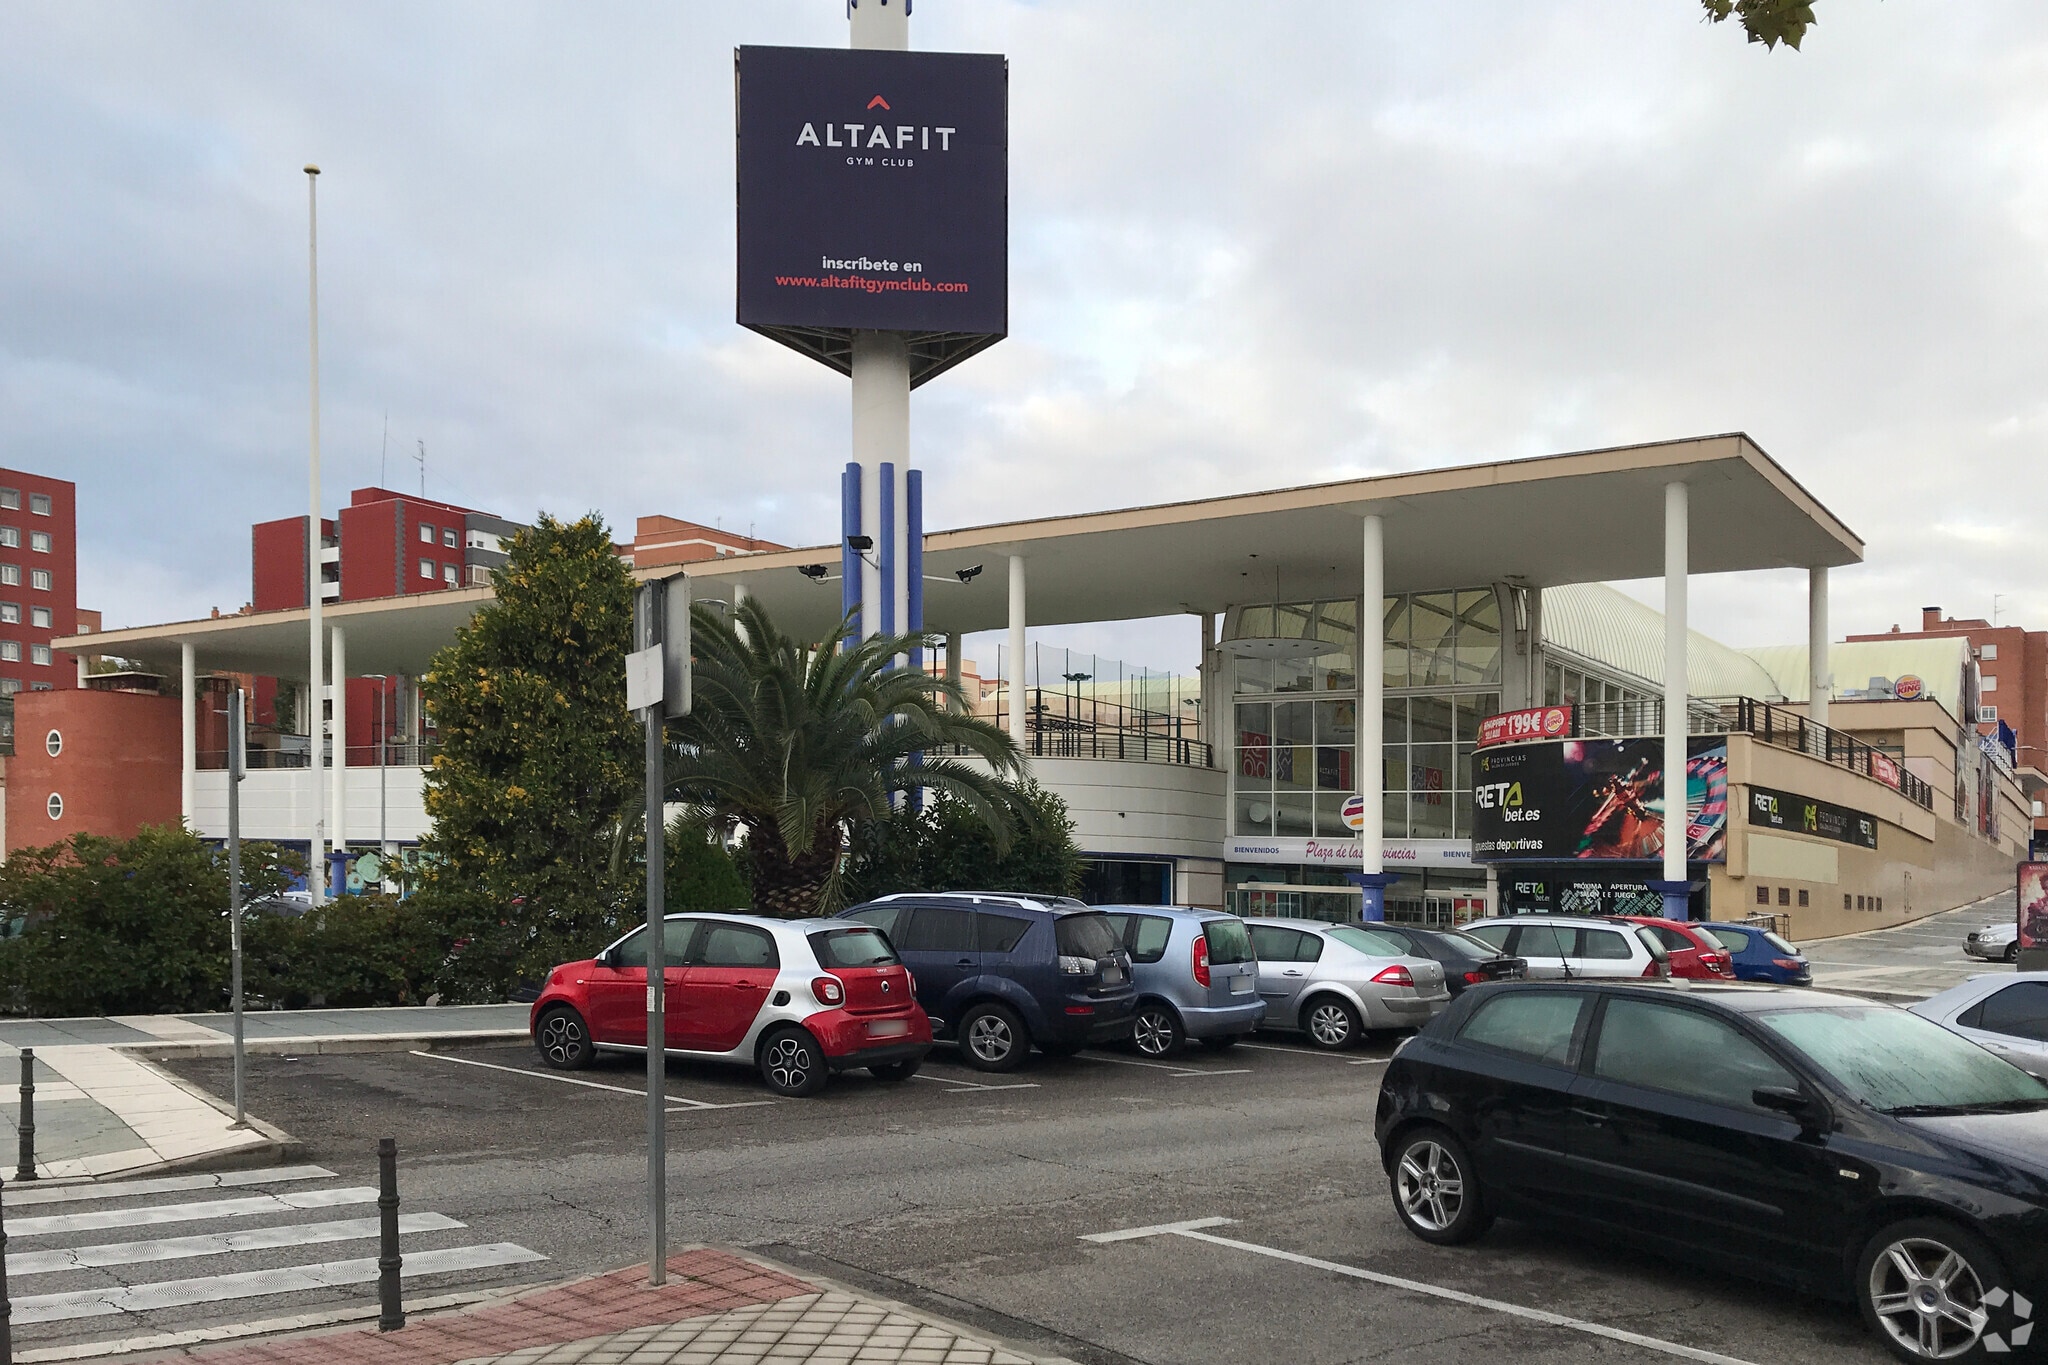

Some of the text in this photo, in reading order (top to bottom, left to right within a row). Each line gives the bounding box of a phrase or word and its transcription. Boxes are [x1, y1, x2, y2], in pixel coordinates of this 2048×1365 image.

[796, 122, 956, 151] ALTAFIT
[846, 157, 914, 167] GYM CLUB
[822, 255, 923, 273] inscríbete en
[775, 274, 969, 294] www.altafitgymclub.com
[1897, 685, 1921, 695] KING
[1475, 781, 1523, 818] RETA
[1755, 793, 1778, 814] RETA
[1504, 807, 1541, 822] bet.es
[1234, 846, 1280, 854] BIENVENIDOS
[1305, 841, 1417, 863] Plaza de las vincias
[1496, 837, 1543, 853] deportivas
[1443, 850, 1472, 858] BIENVE
[1515, 882, 1545, 897] RETA
[1610, 883, 1649, 891] APERTURA
[1614, 891, 1637, 899] JUEGO
[1646, 892, 1664, 912] RET
